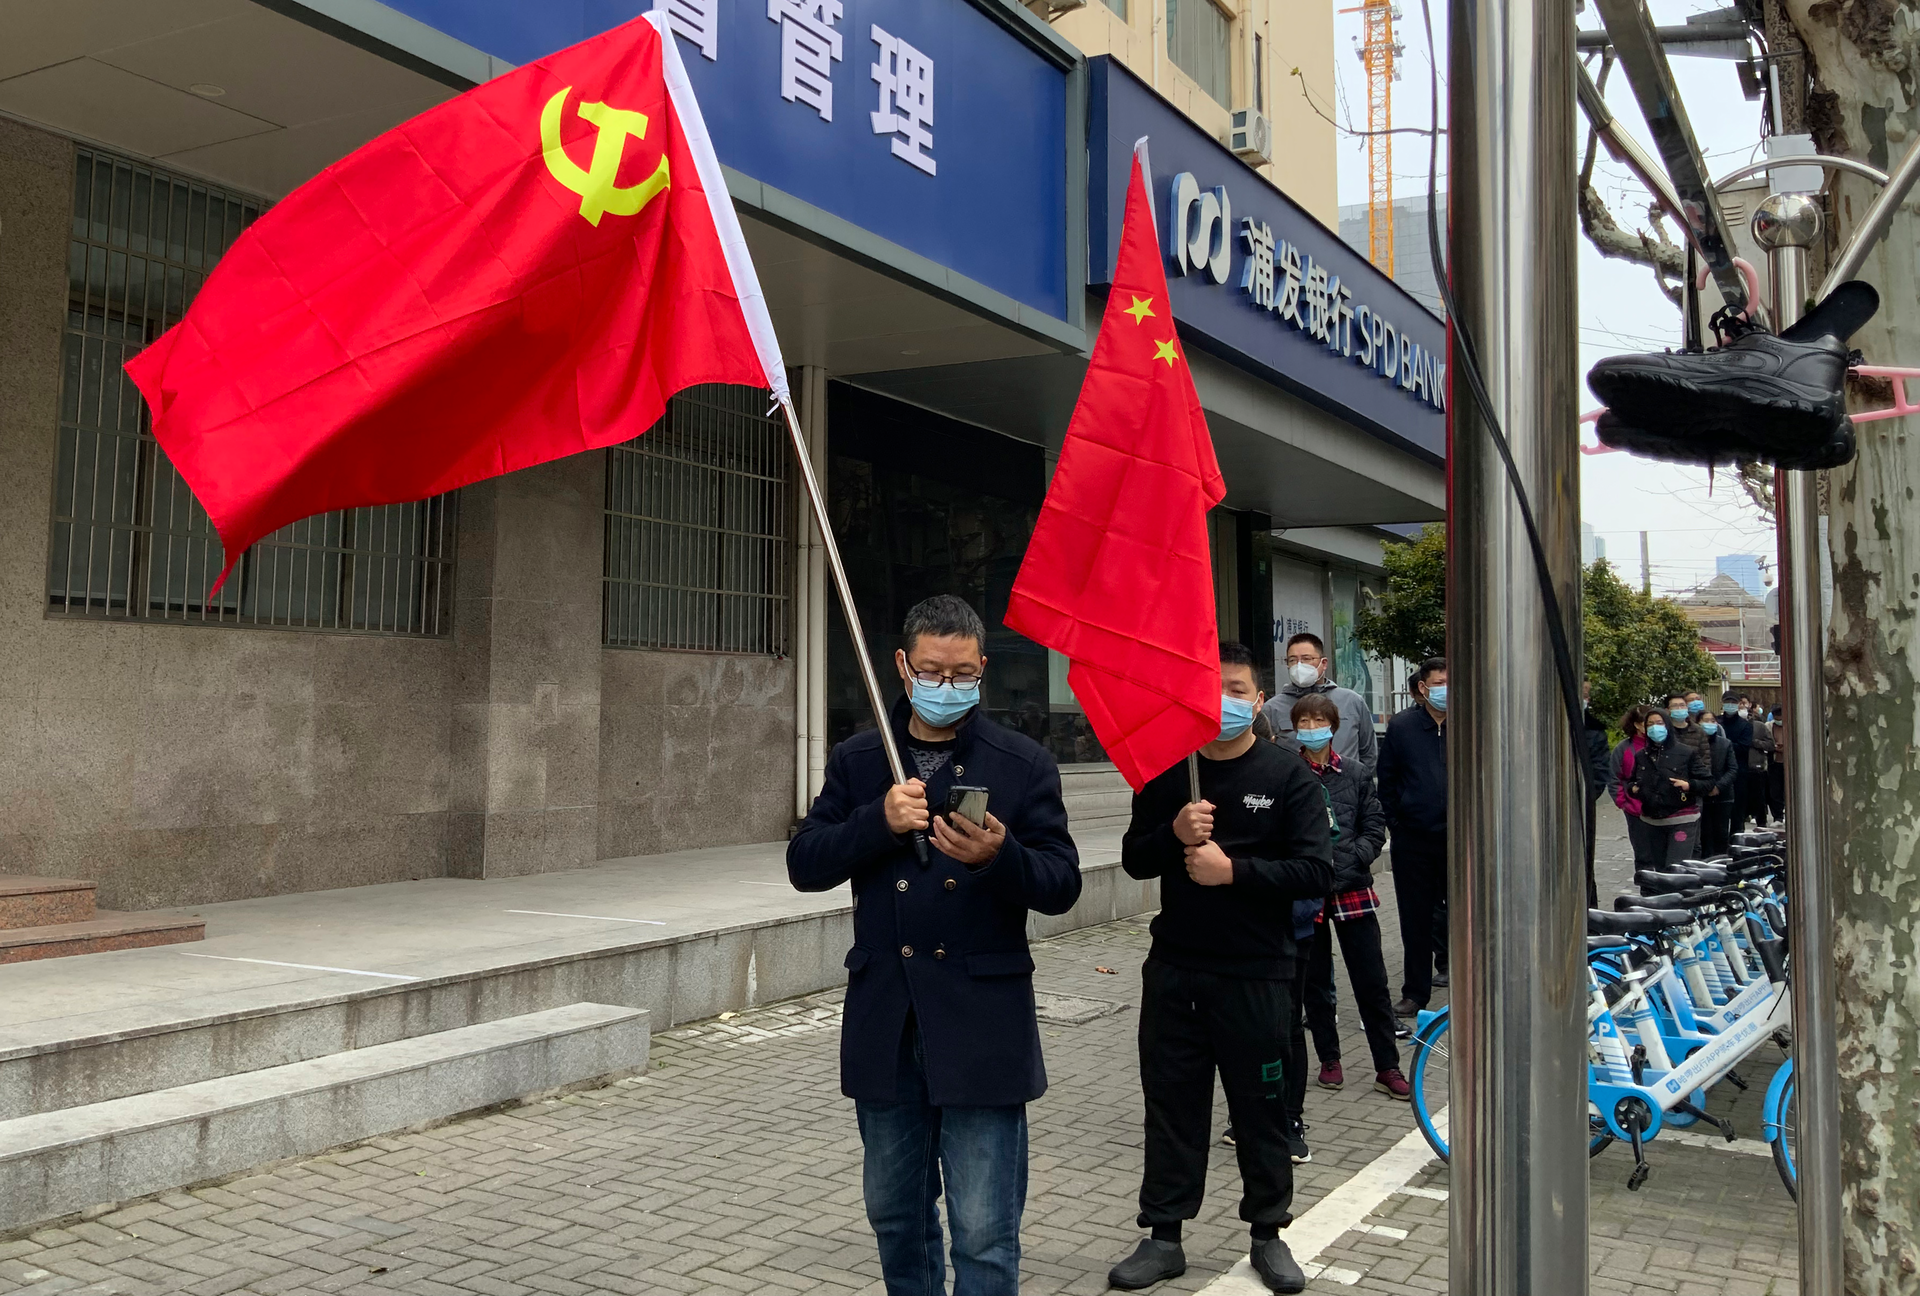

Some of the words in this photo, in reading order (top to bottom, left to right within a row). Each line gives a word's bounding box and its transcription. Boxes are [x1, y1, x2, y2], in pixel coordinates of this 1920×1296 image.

[1239, 216, 1354, 358] 浦发银行
[1708, 940, 1718, 952] P
[1695, 950, 1706, 961] P
[1598, 1022, 1611, 1037] P
